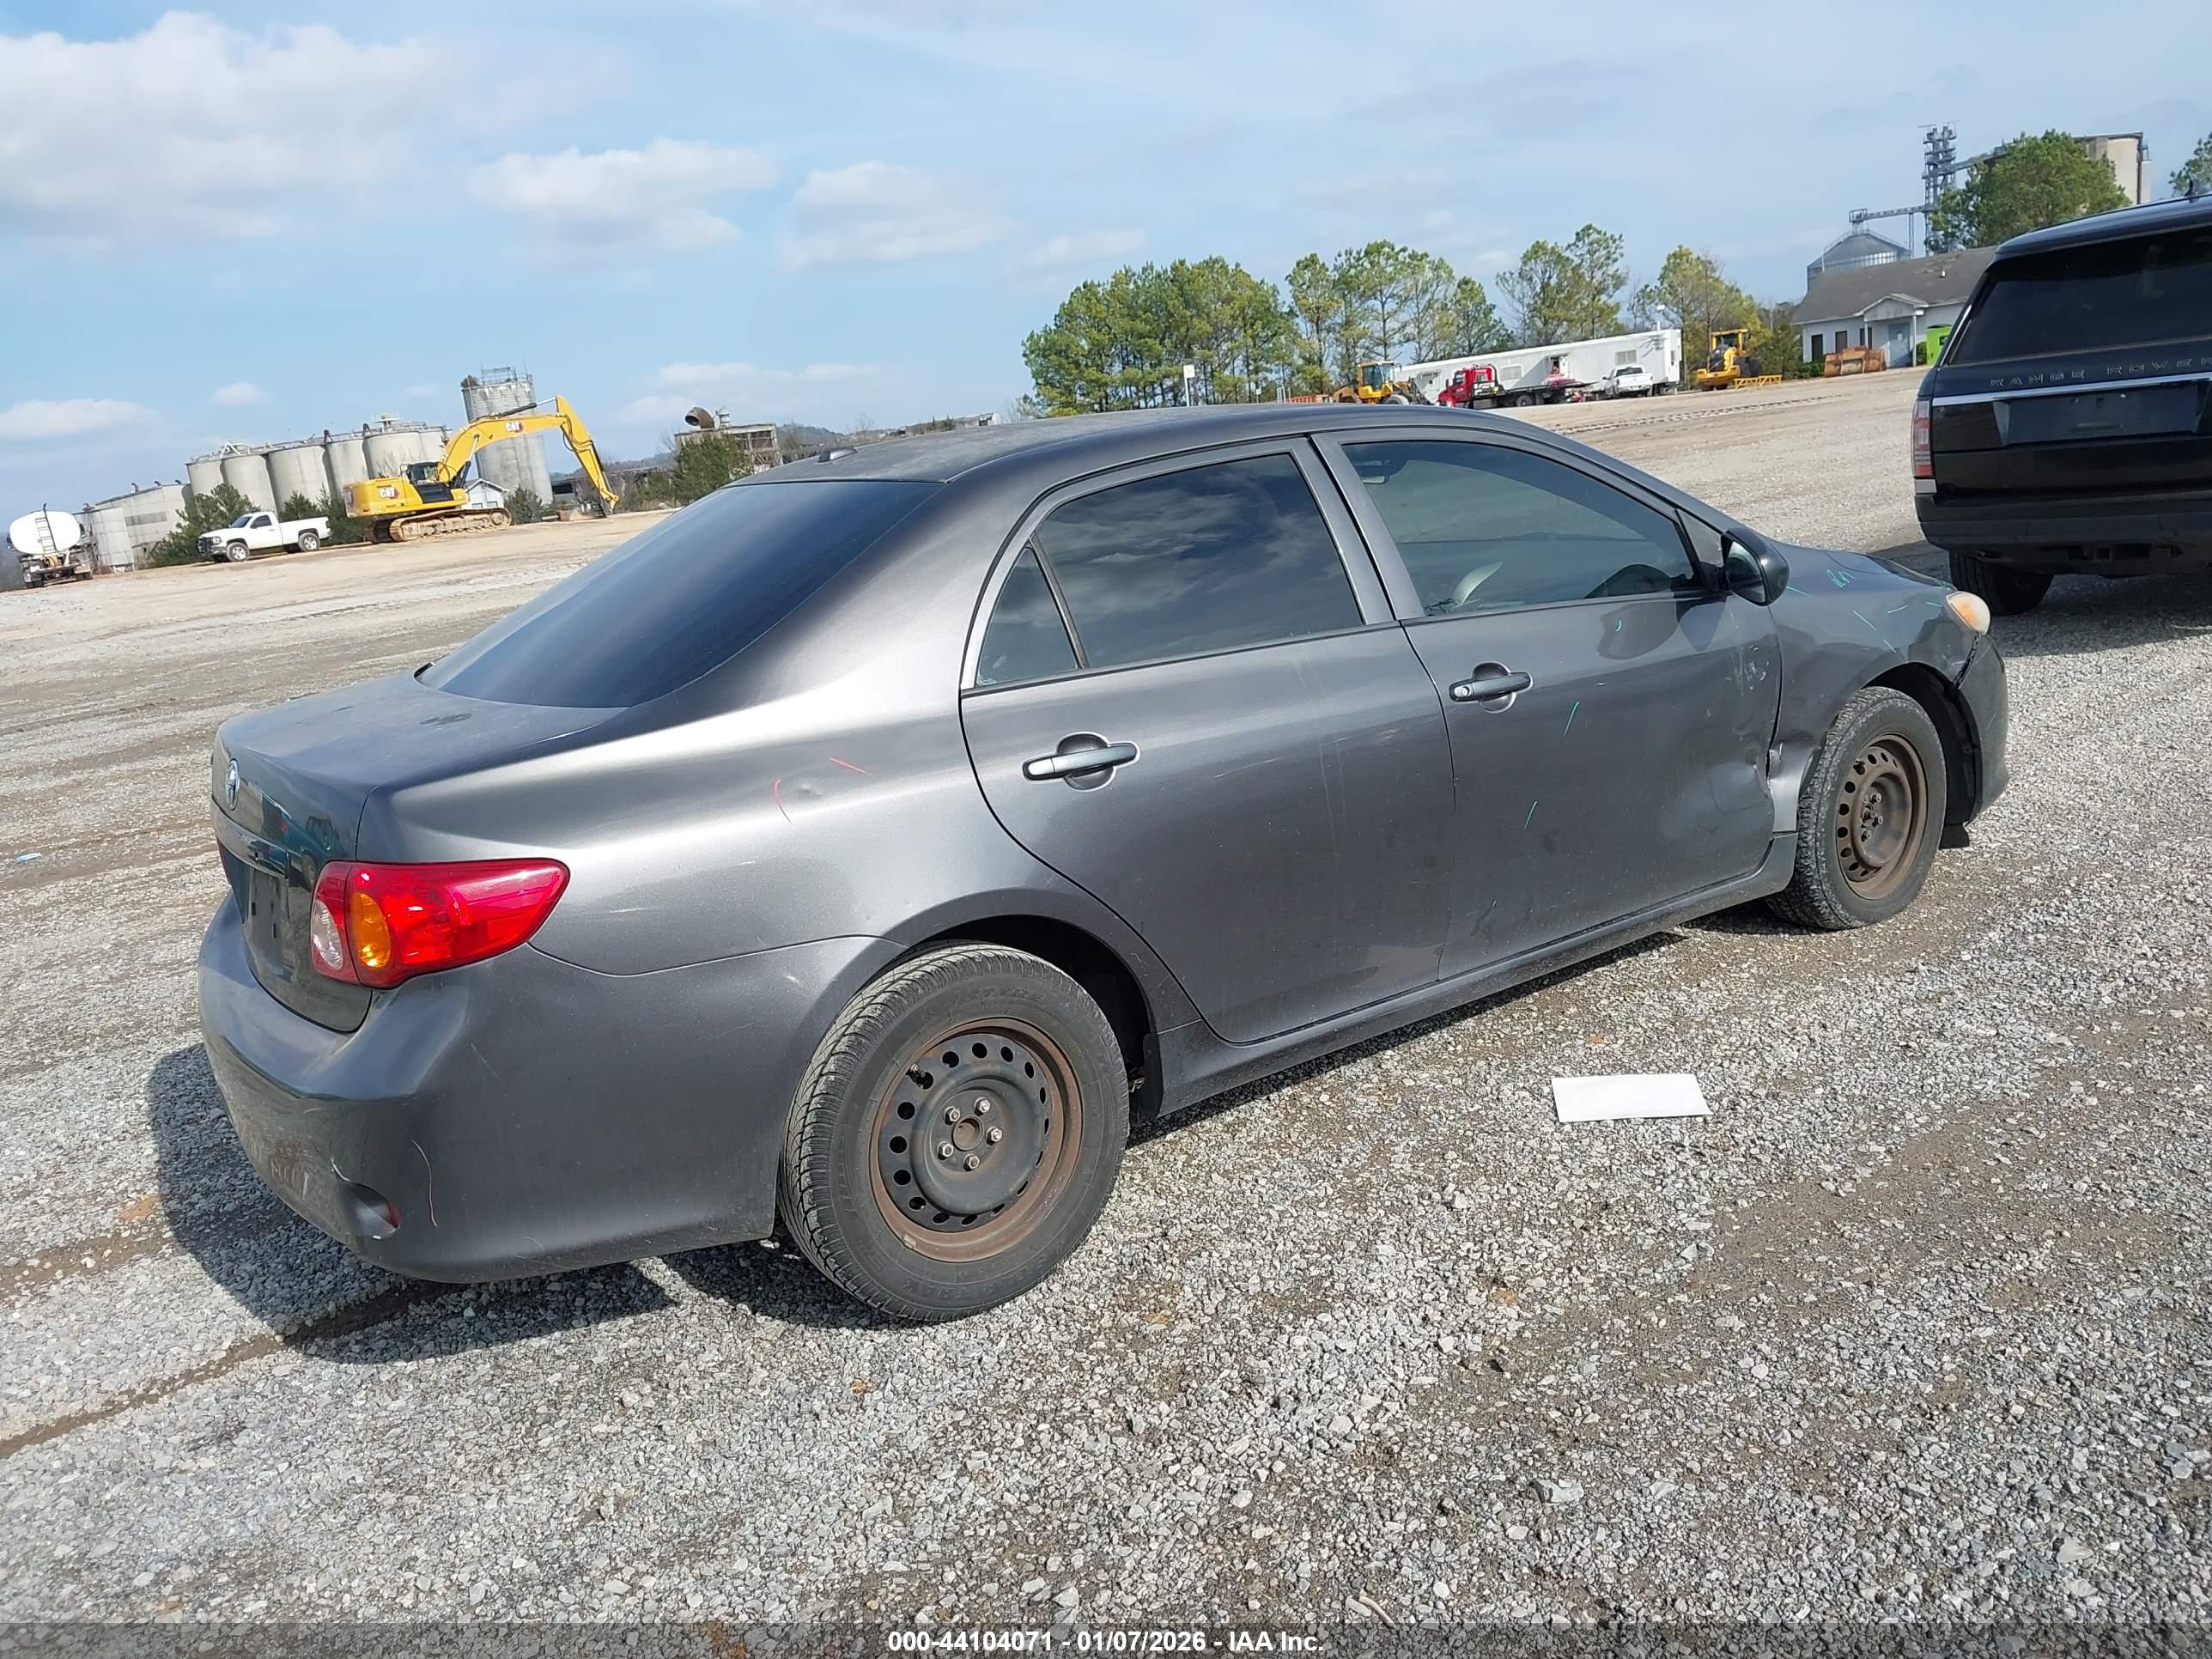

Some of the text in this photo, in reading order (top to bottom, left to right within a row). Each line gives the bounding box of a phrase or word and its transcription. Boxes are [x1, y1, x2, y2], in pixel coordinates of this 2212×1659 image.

[1990, 369, 2085, 386] RANGE
[505, 421, 520, 432] CAT
[380, 487, 395, 498] CAT
